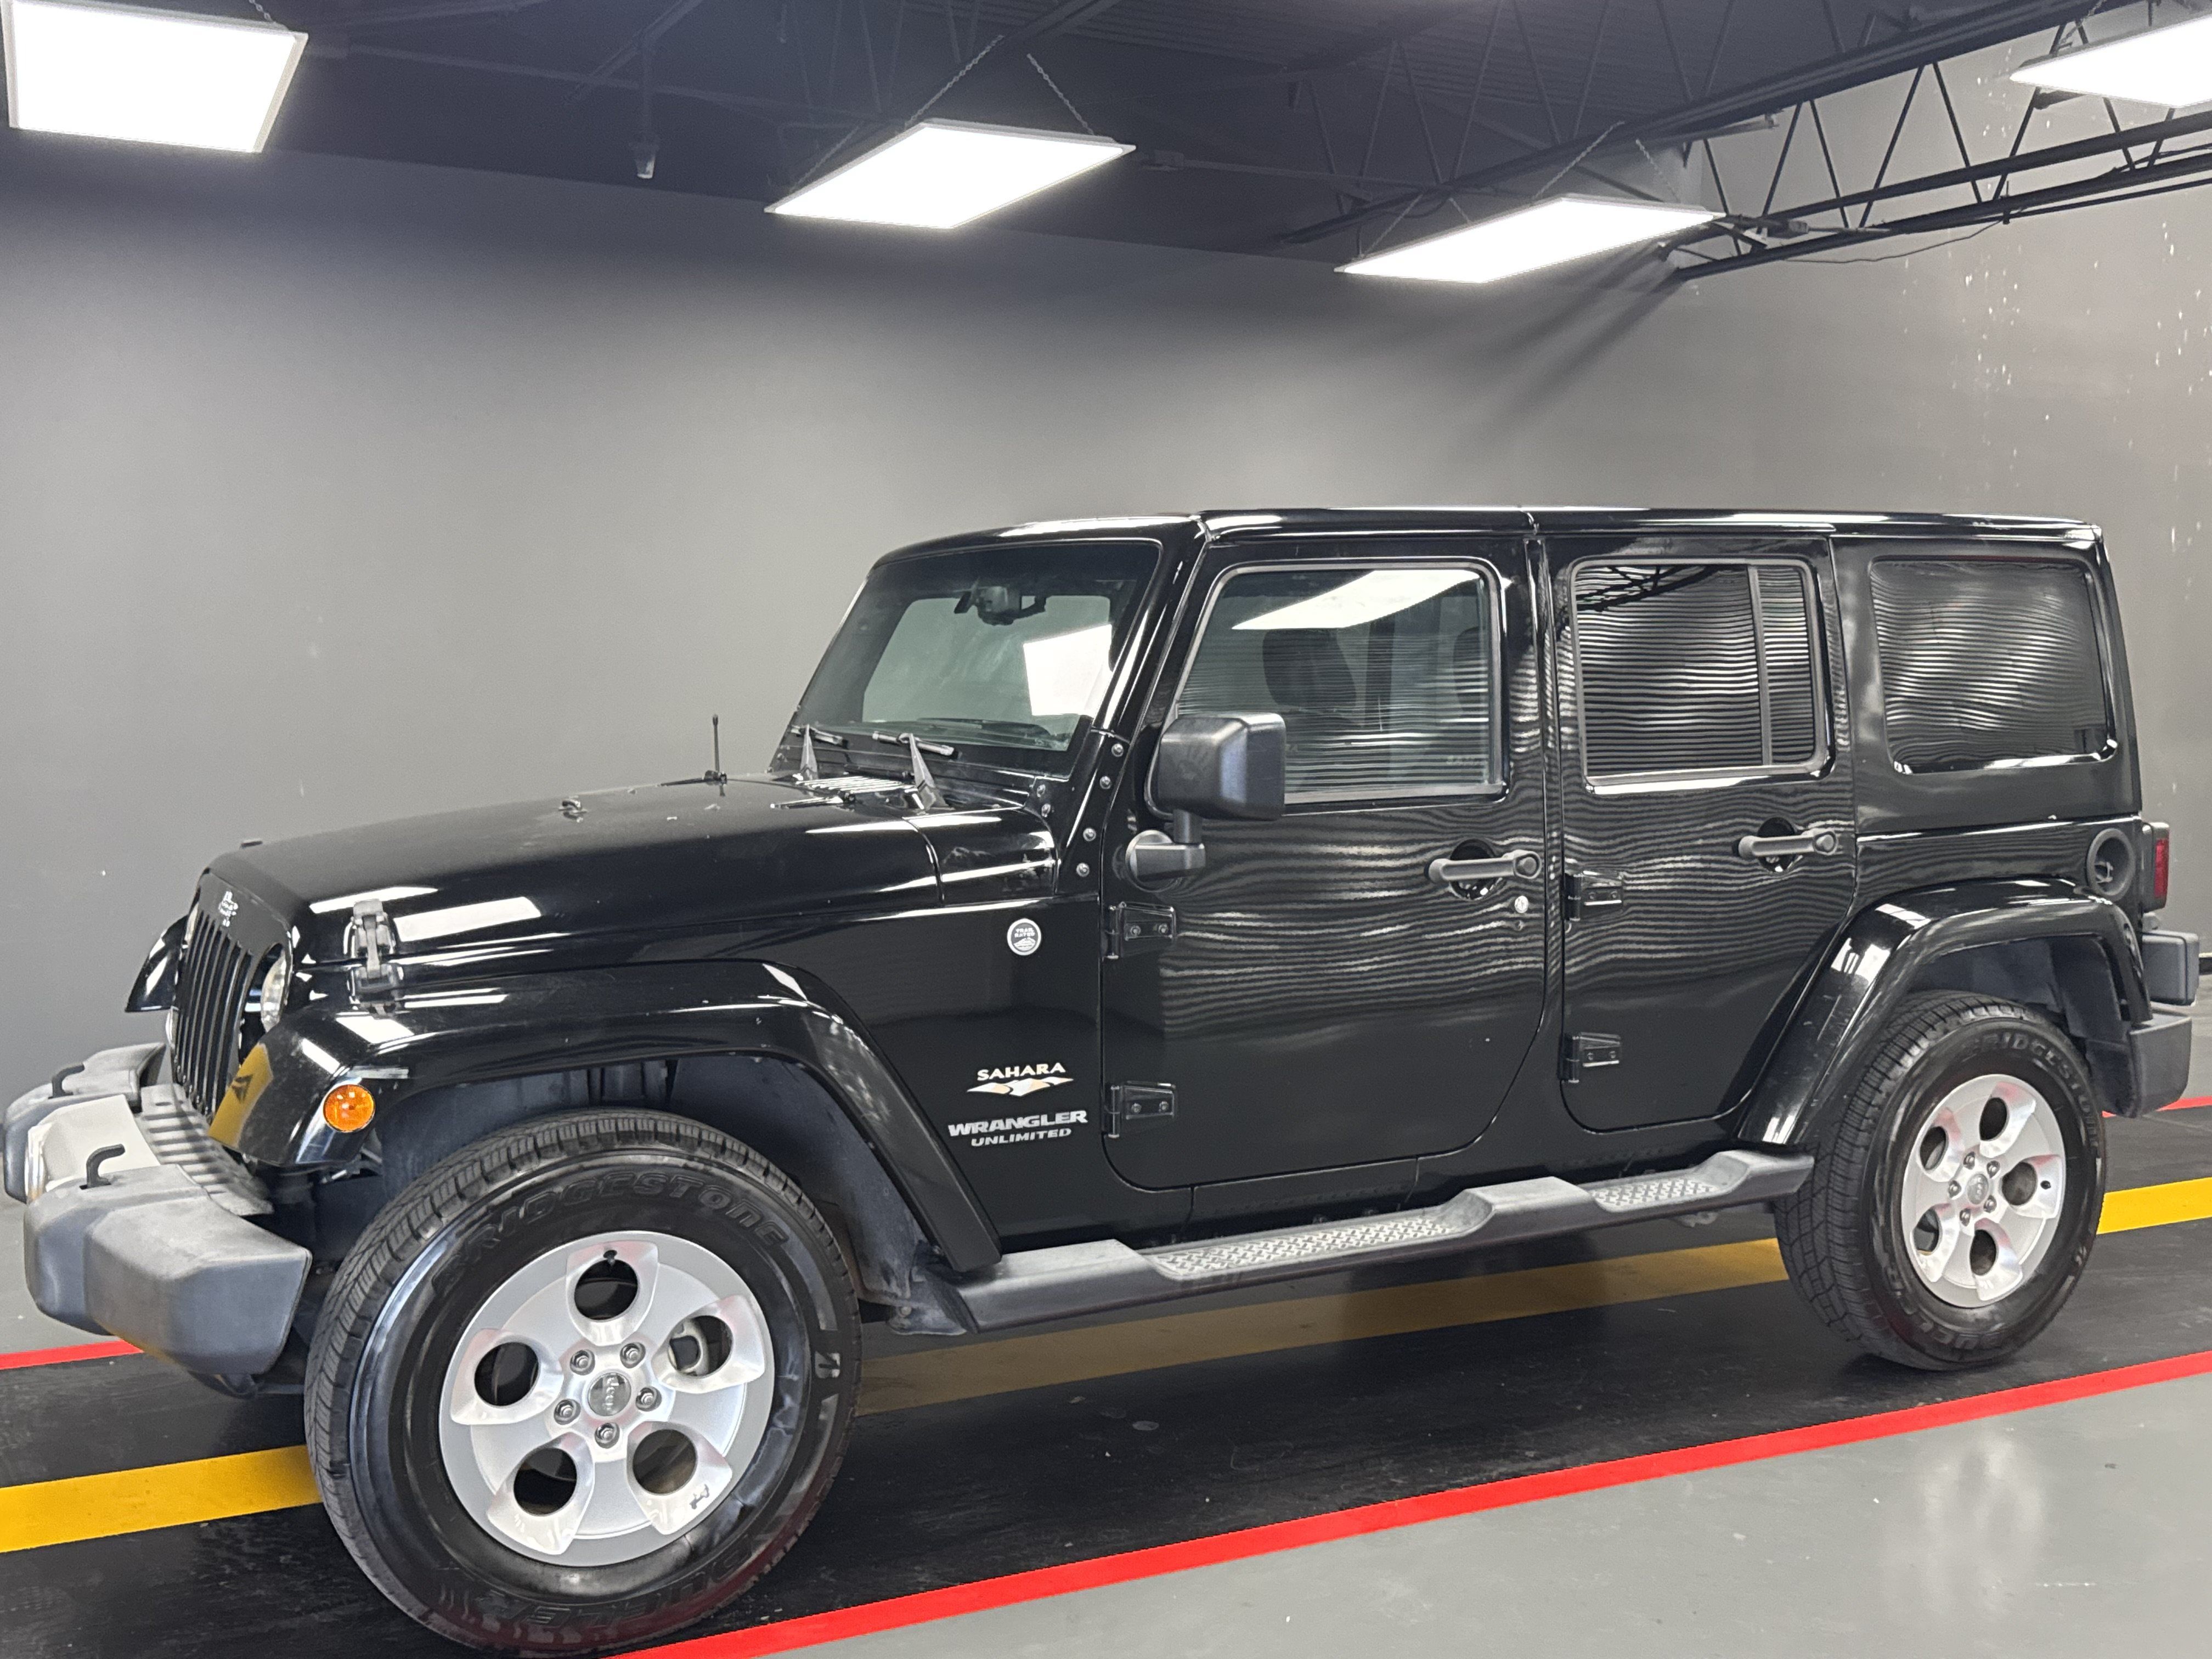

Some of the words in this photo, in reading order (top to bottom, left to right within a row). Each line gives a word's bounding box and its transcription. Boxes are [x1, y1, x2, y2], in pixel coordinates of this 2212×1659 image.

[977, 1062, 1066, 1081] SAHARA
[947, 1110, 1088, 1137] WRANGLER
[971, 1128, 1072, 1147] UNLIMITED
